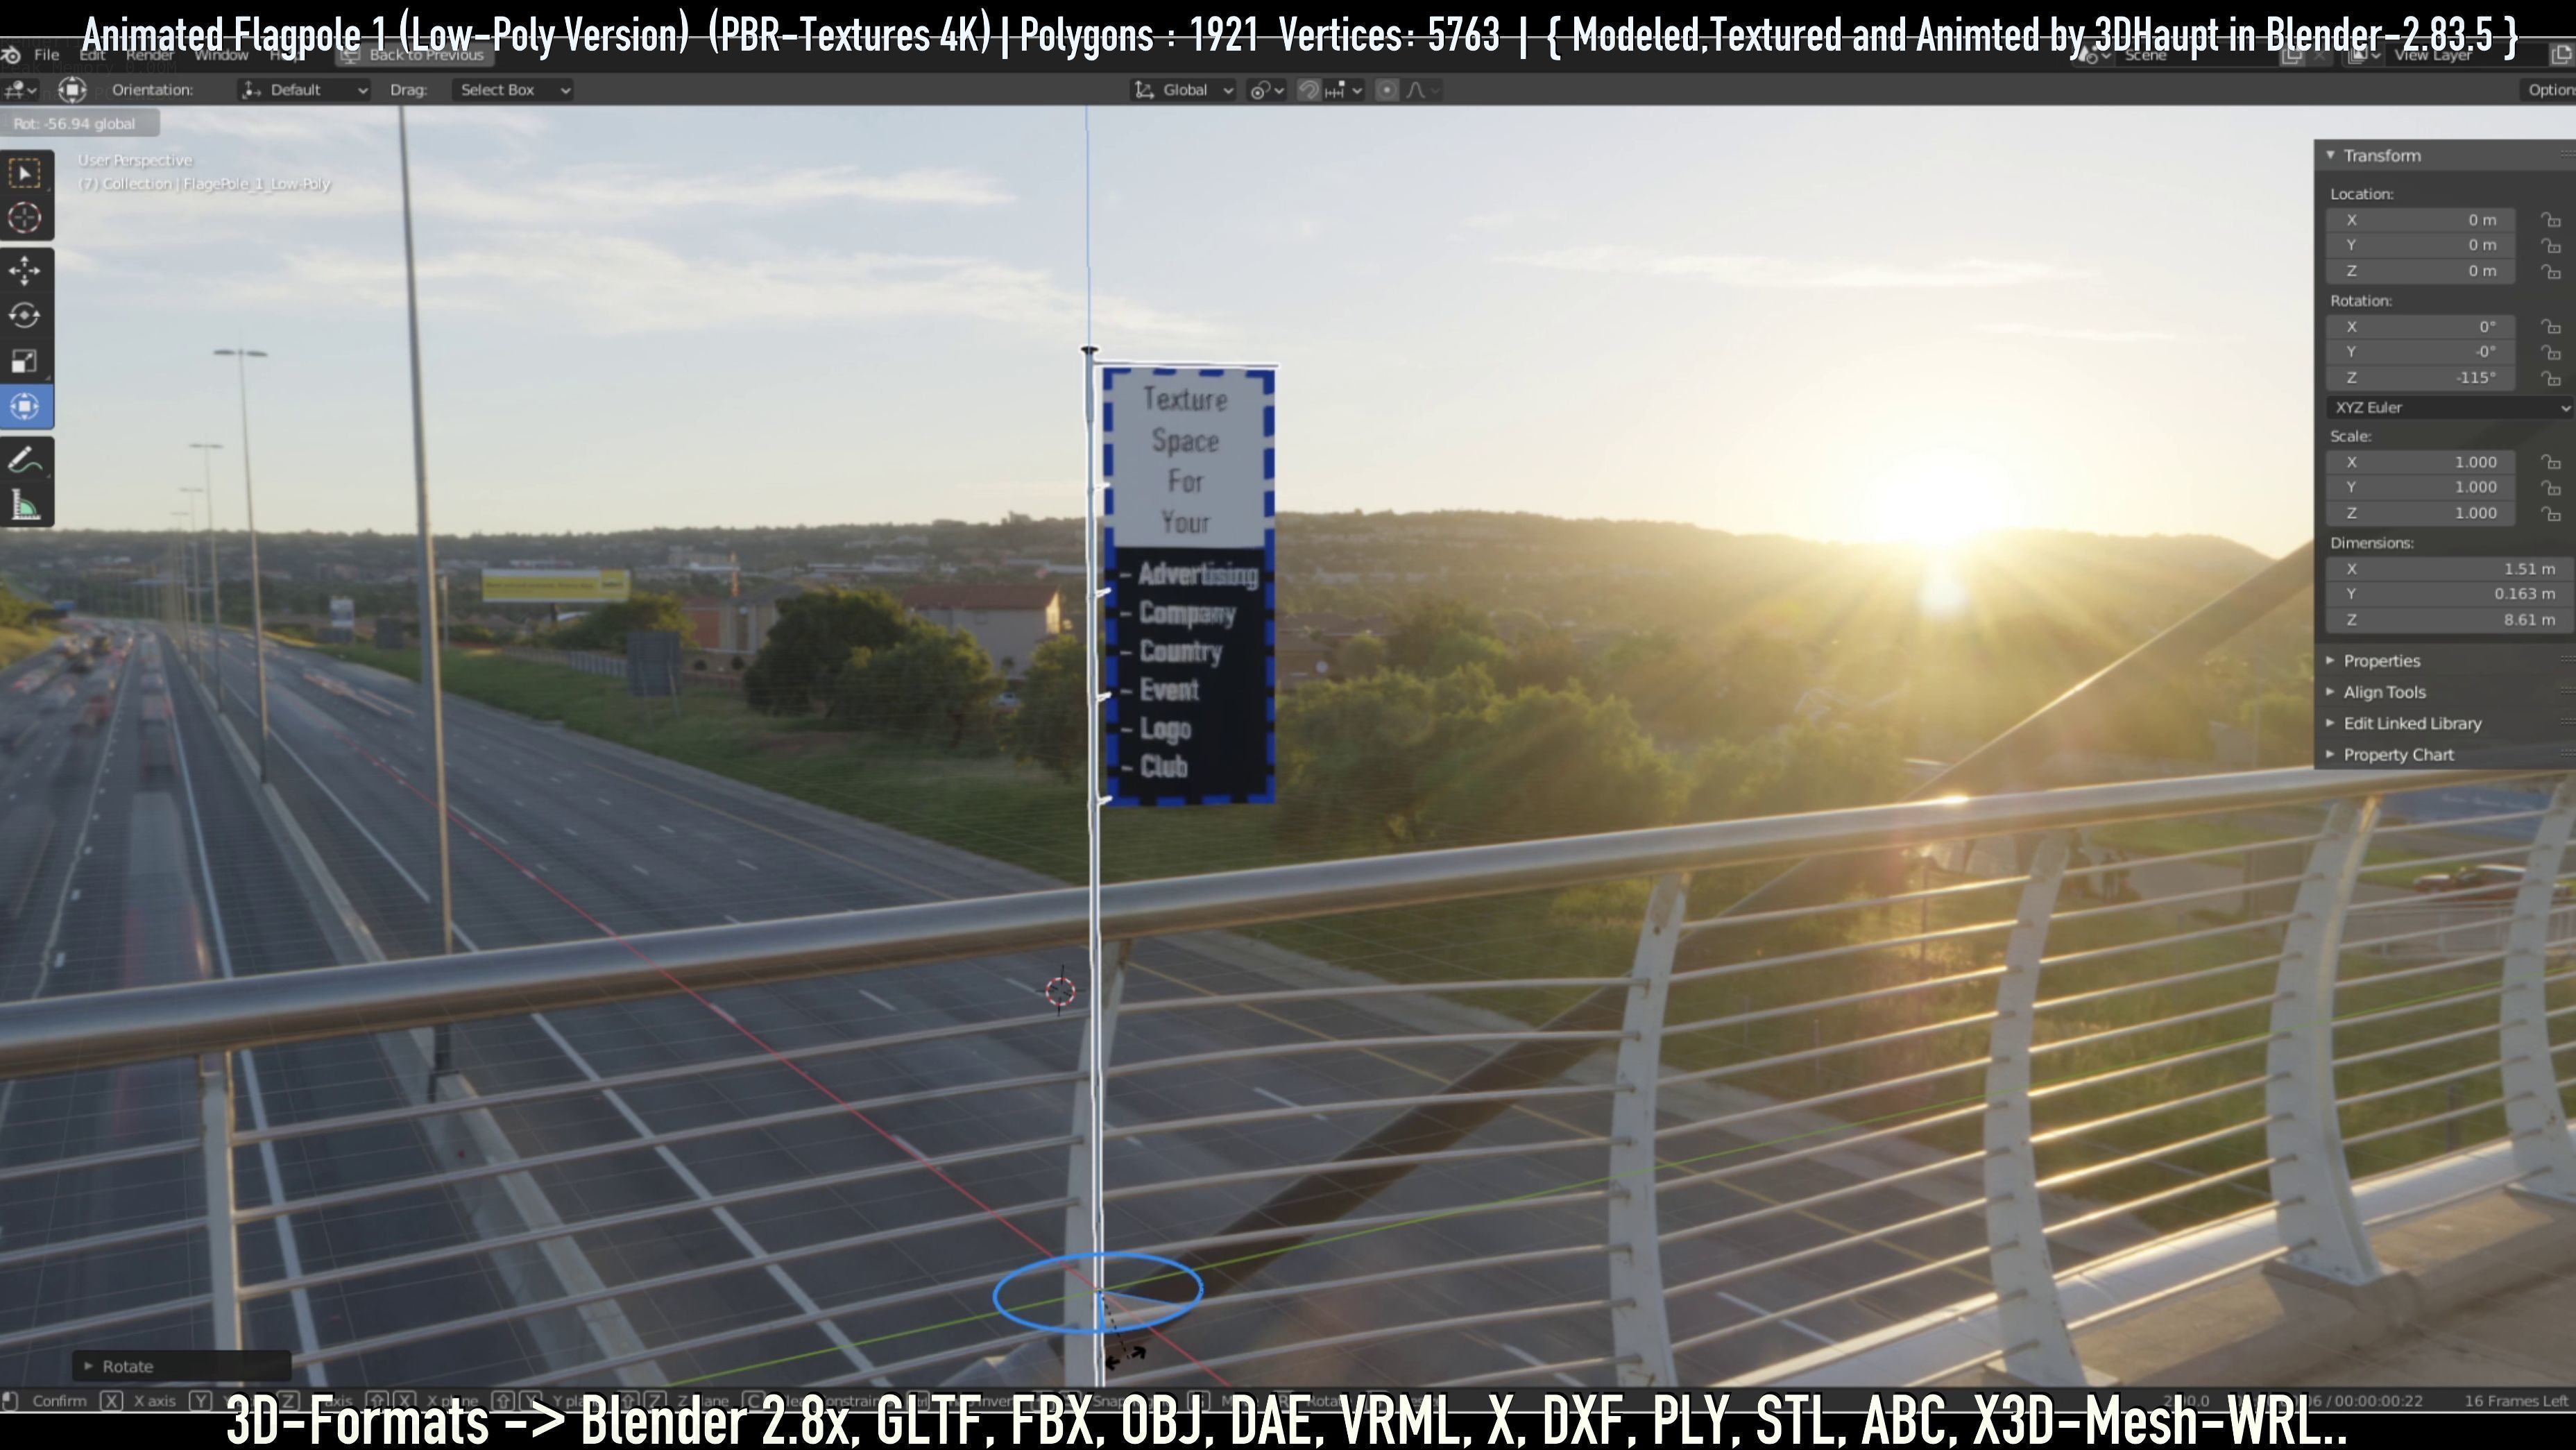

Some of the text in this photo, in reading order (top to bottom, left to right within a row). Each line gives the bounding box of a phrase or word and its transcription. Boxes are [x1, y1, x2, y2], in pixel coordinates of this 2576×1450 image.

[35, 49, 59, 60] File
[80, 49, 106, 61] Edit
[126, 49, 174, 61] Render
[195, 49, 249, 61] Window
[270, 49, 301, 64] Hp
[370, 49, 484, 61] Back to Previous
[2125, 48, 2167, 62] Scene
[2395, 49, 2473, 64] View Layer
[112, 83, 194, 97] Orientation:
[272, 84, 321, 96] Default
[391, 84, 427, 99] Drag:
[462, 84, 534, 96] Select Box
[1164, 84, 1206, 96] Global
[2530, 83, 2576, 99] Option
[14, 118, 135, 132] Rot: -56.94 global
[78, 154, 193, 169] User Perspective
[2344, 149, 2421, 162] Transform
[78, 178, 99, 191] (7)
[104, 178, 172, 191] Collection
[2332, 189, 2393, 200] Location:
[2348, 214, 2356, 225] X
[2470, 214, 2496, 225] 0 m
[2347, 239, 2355, 250] Y
[2470, 239, 2496, 250] 0 m
[2347, 265, 2357, 276] Z
[2470, 265, 2496, 276] 0 m
[2332, 295, 2391, 307] Rotation:
[2348, 322, 2357, 332] X
[2347, 346, 2355, 357] Y
[2347, 372, 2357, 383] Z
[1144, 386, 1227, 411] Texture
[2337, 402, 2403, 413] XYZ Euler
[1153, 427, 1219, 457] Space
[2331, 430, 2371, 442] Scale:
[2348, 457, 2357, 468] X
[2457, 457, 2496, 468] 1.000
[1169, 468, 1204, 493] For
[2347, 481, 2355, 493] Y
[2457, 481, 2496, 493] 1.000
[2347, 507, 2357, 518] Z
[2457, 507, 2497, 518] 1.000
[1163, 511, 1209, 534] Your
[2332, 537, 2413, 549] Dimensions:
[2348, 563, 2356, 574] X
[2506, 563, 2555, 574] 1.51 m
[1138, 561, 1259, 590] Advertising
[2347, 588, 2355, 599] Y
[2496, 588, 2555, 599] 0.163 m
[1139, 599, 1237, 630] Company
[2348, 614, 2357, 626] Z
[2505, 614, 2555, 625] 8.61 m
[1140, 638, 1223, 667] Country
[2346, 655, 2421, 669] Properties
[1140, 676, 1200, 701] Event
[2344, 685, 2426, 701] Align Tools
[2346, 717, 2482, 733] Edit Linked Library
[1140, 717, 1192, 746] Logo
[2345, 749, 2455, 764] Property Chart
[1140, 753, 1188, 778] Club
[104, 1361, 153, 1373] Rotate
[33, 1395, 86, 1406] Confirm
[135, 1396, 176, 1406] X axis
[428, 1395, 479, 1410] X pane
[552, 1396, 562, 1408] Y
[678, 1396, 688, 1408] Z
[2466, 1395, 2568, 1408] 16 Frames Left
